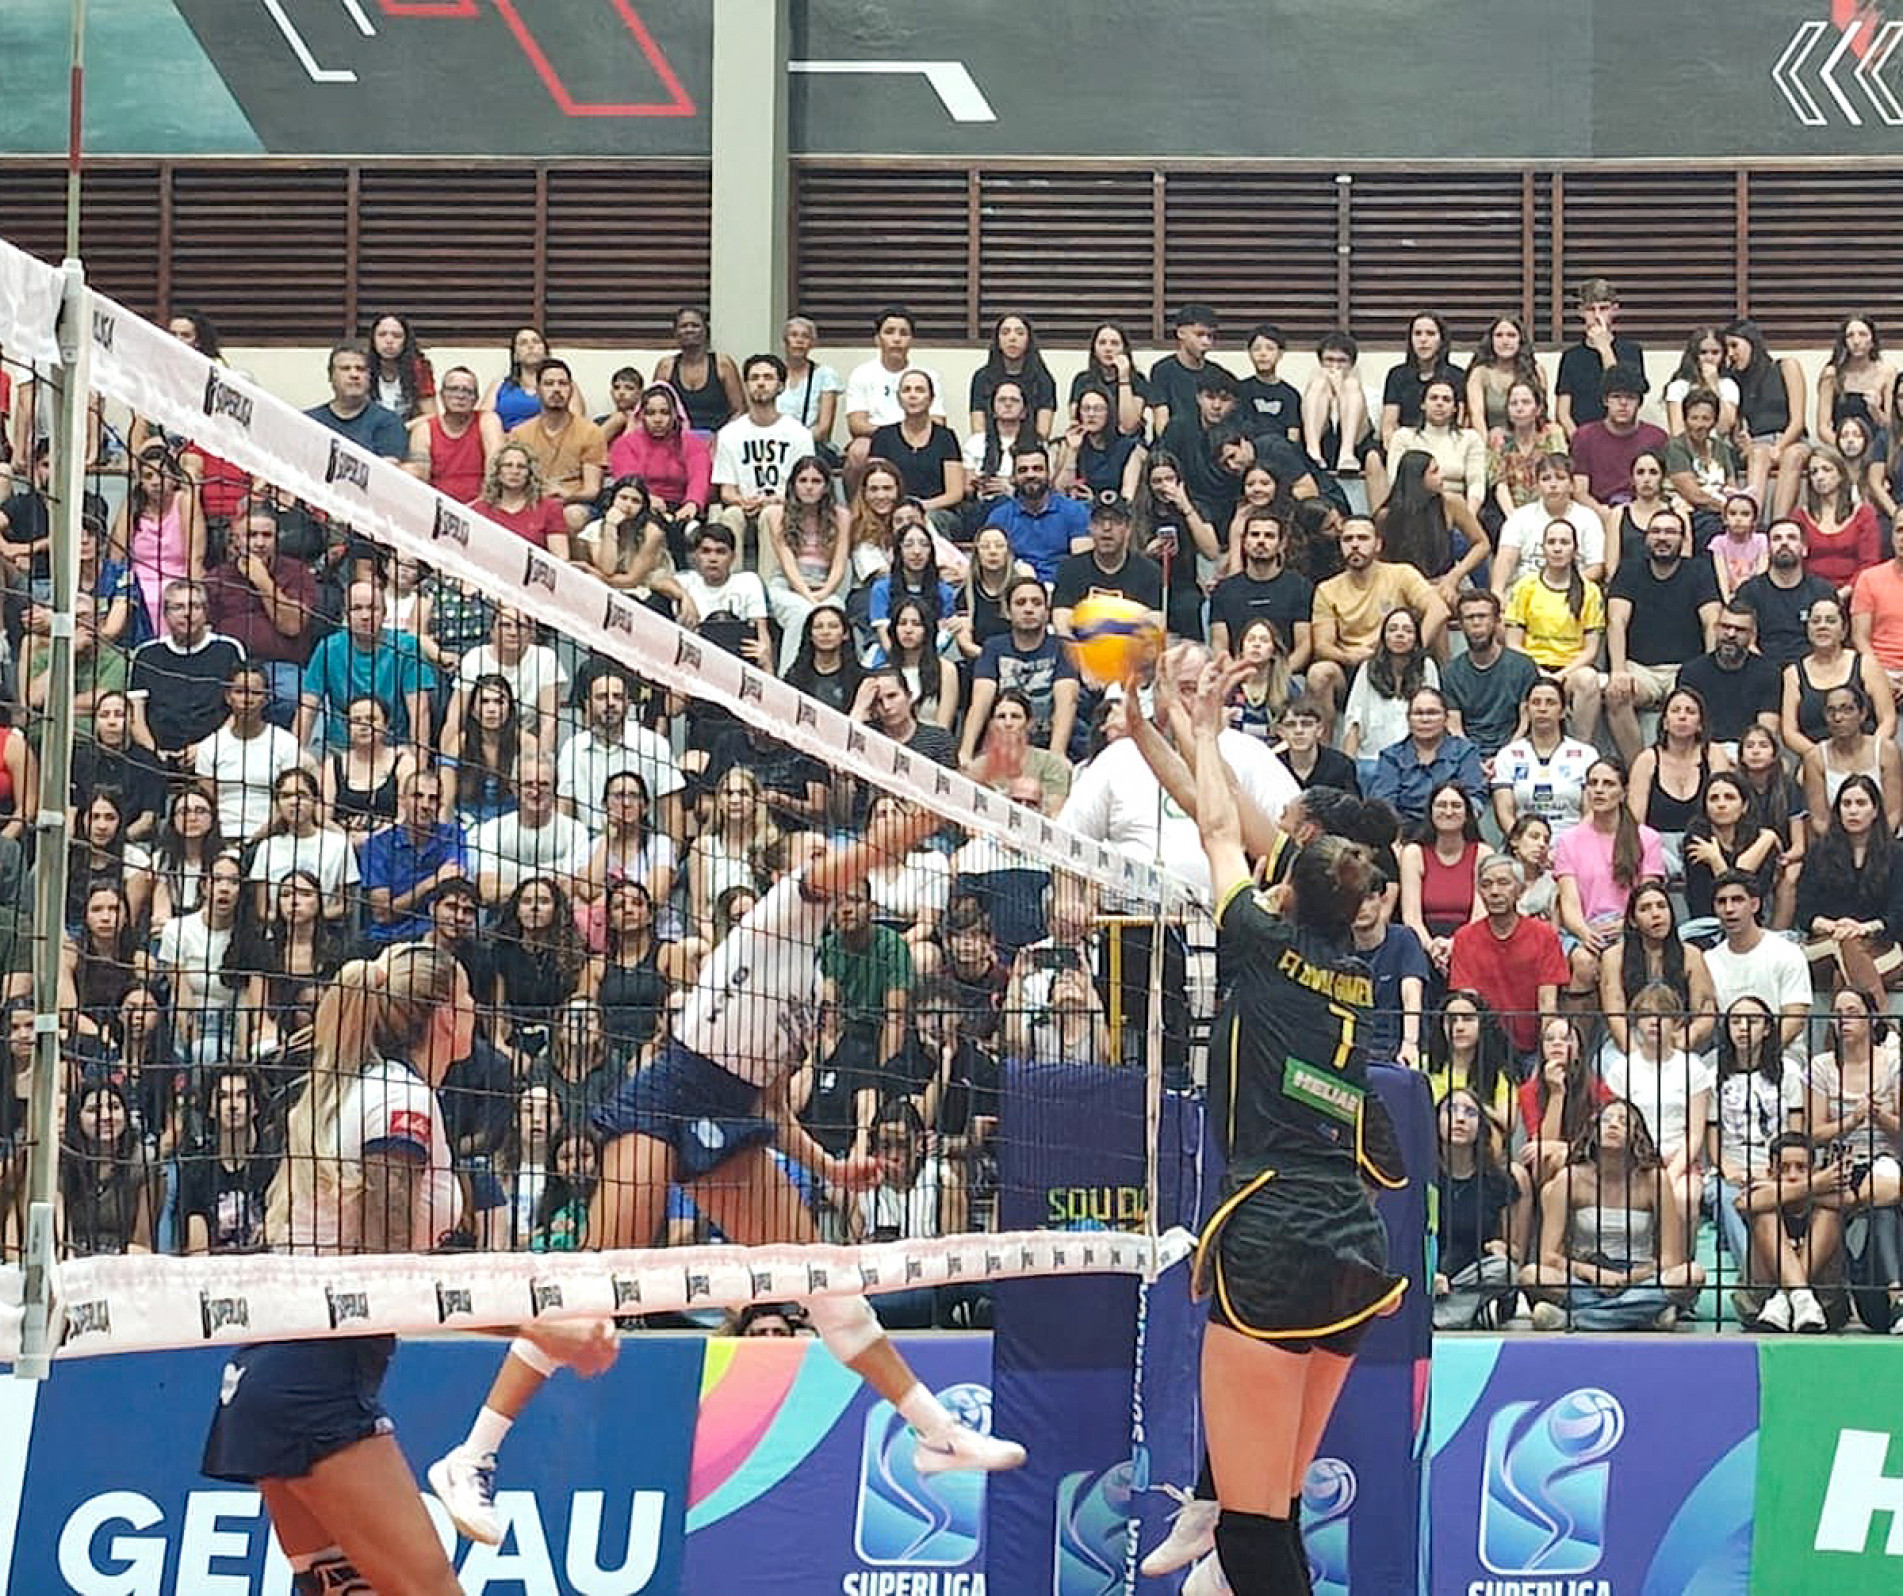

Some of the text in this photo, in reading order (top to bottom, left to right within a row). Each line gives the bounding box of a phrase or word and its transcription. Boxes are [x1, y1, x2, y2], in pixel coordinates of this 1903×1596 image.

[741, 438, 791, 465] JUST
[57, 1489, 665, 1596] GEAU
[842, 1571, 986, 1596] SUPERLIGA
